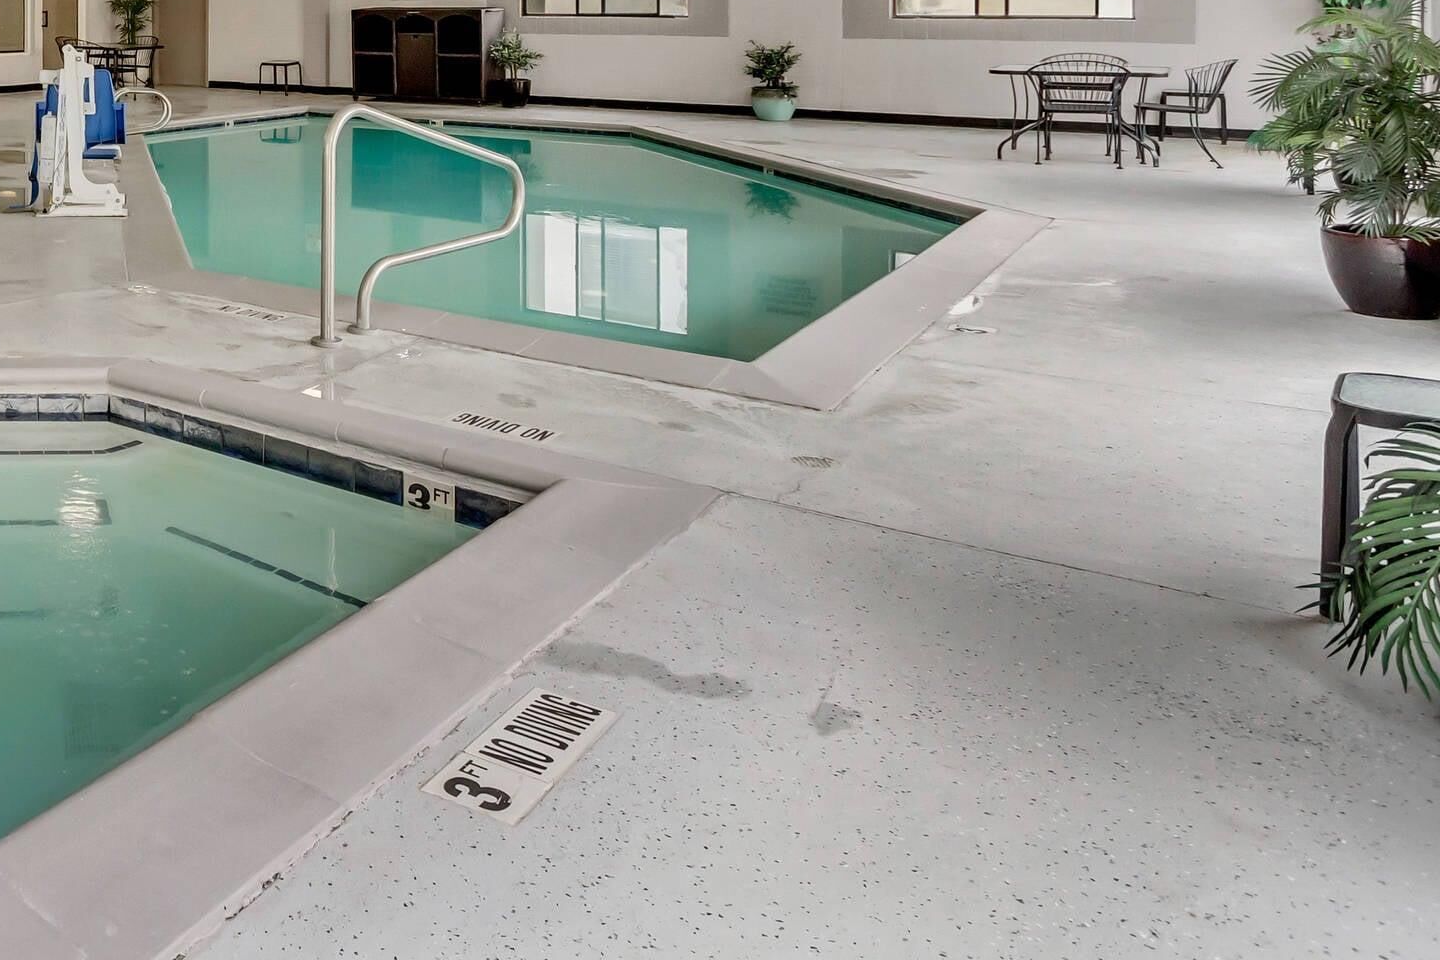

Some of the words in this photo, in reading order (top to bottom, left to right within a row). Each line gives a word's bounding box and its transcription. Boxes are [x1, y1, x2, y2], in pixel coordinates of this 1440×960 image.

[452, 413, 521, 433] DIVING
[520, 428, 555, 441] NO
[408, 483, 430, 510] 3
[434, 488, 450, 504] FT
[504, 694, 602, 750] DIVING
[459, 759, 488, 778] FT
[479, 738, 554, 775] NO
[443, 777, 512, 812] 3
